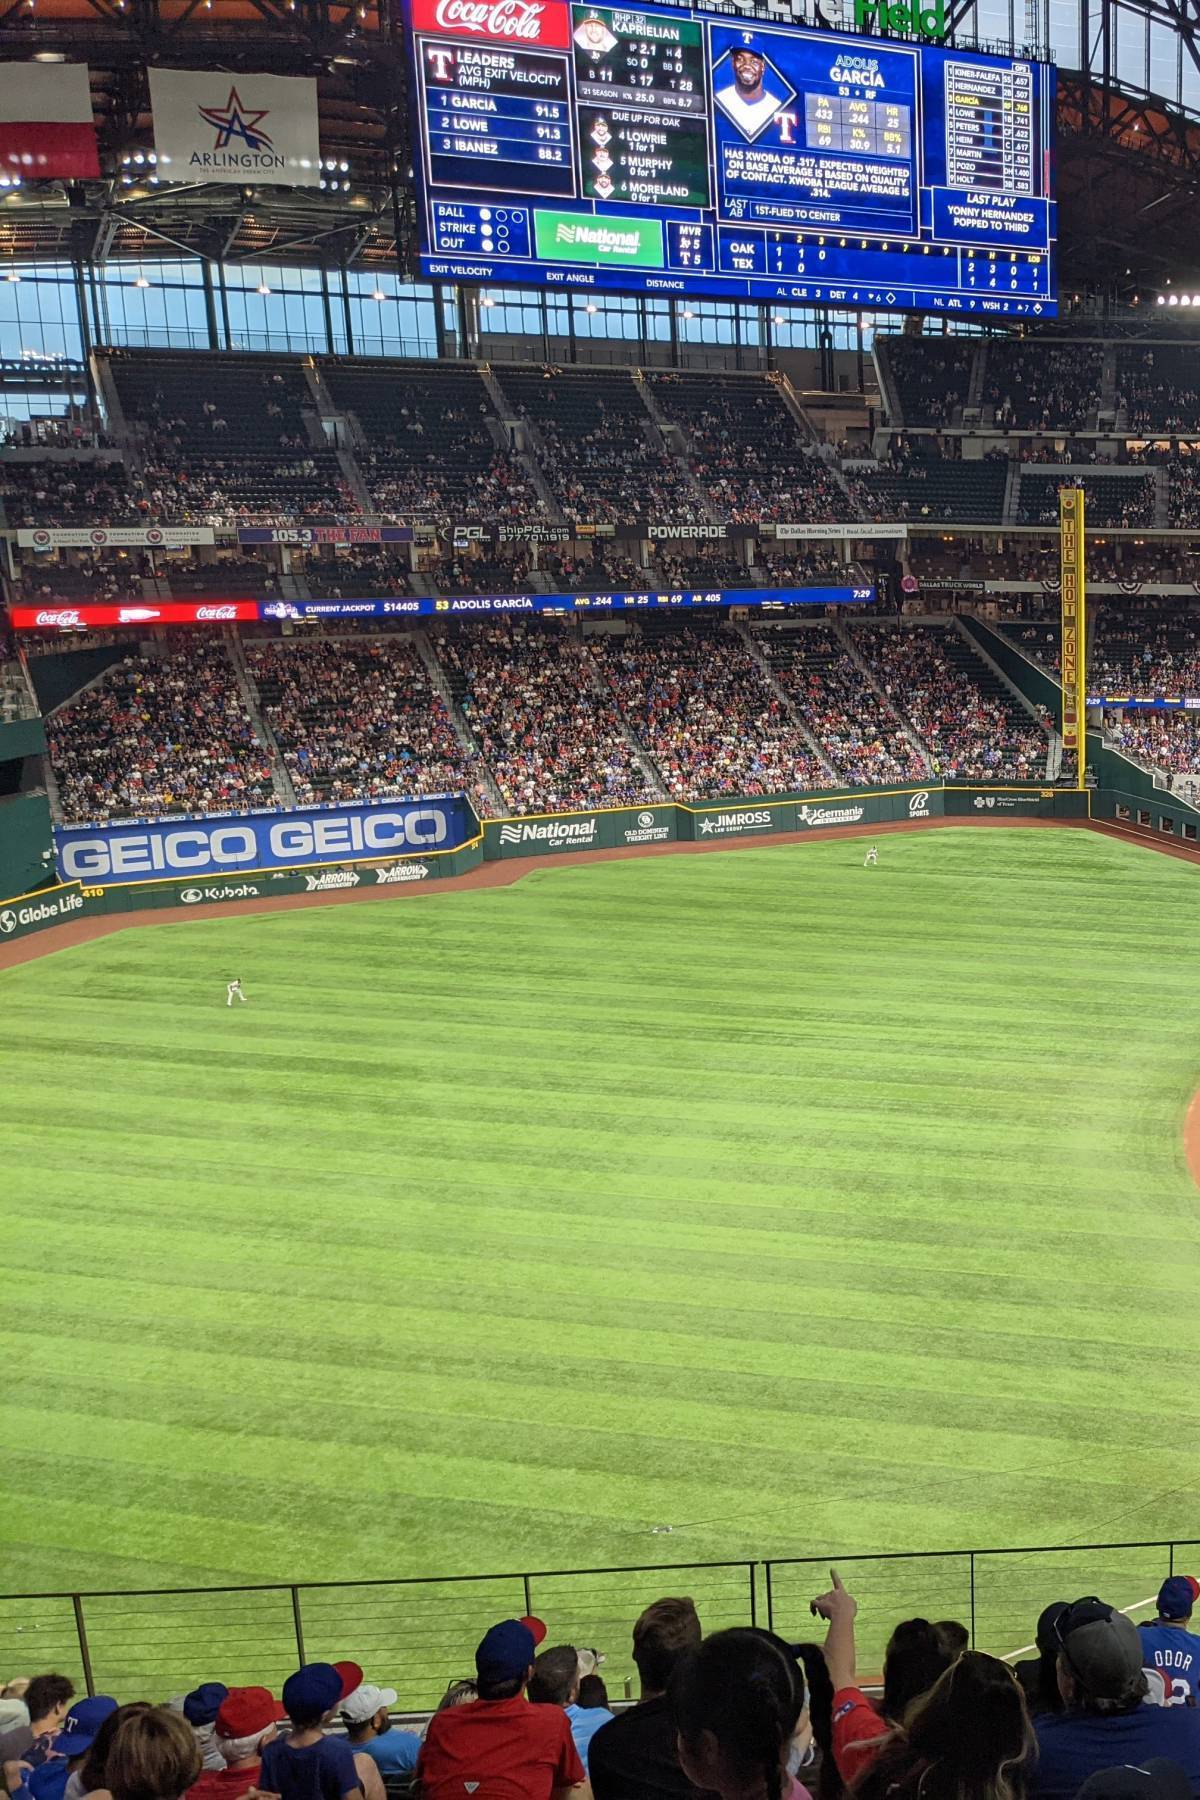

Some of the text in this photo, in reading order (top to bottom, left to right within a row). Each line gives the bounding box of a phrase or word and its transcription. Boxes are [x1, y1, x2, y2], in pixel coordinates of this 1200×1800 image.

[436, 0, 546, 39] Coca-Cola
[854, 0, 945, 37] Field
[612, 22, 680, 40] KAPRIELIAN
[457, 50, 515, 69] LEADERS
[836, 55, 879, 71] ADOLIS
[458, 65, 562, 86] AVG EXIT VELOCITY
[459, 75, 491, 89] (MPH)
[829, 67, 886, 88] GARCÍA
[452, 97, 560, 119] GARCIA 91.5
[612, 112, 680, 127] DUE UP FOR OAK
[454, 118, 561, 140] LOWE 91.3
[627, 131, 667, 145] LOWRIE
[455, 140, 562, 161] IBANEZ 88.2
[189, 152, 285, 168] ARLINGTON
[628, 157, 673, 170] MURPHY
[724, 149, 744, 160] HAS
[745, 151, 780, 164] XWOBA
[782, 155, 795, 165] OF
[819, 160, 864, 173] EXPECTED
[865, 164, 910, 178] WEIGHTED
[728, 159, 907, 187] ON BASE AVERAGE IS BASED ON QUALITY
[629, 182, 689, 197] MORELAND
[726, 169, 910, 197] OF CONTACT. XWOBA LEAGUE AVERAGE IS
[724, 198, 749, 209] LAST
[966, 193, 1016, 208] LAST PLAY
[438, 206, 465, 218] BALL
[729, 209, 743, 218] AB
[755, 205, 841, 222] 1ST-FLIED TO CENTER
[947, 205, 1034, 223] YONNY HERNANDEZ
[440, 222, 476, 234] STRIKE
[953, 217, 1030, 233] POPPED TO THIRD
[441, 237, 465, 249] OUT
[575, 226, 640, 247] National
[730, 243, 755, 254] OAK
[429, 264, 493, 277] EXIT VELOCITY
[732, 258, 754, 270] TEX
[546, 271, 595, 284] EXIT ANGLE
[646, 279, 685, 289] DISTANCE
[271, 528, 381, 542] 105.3 THE FAN
[453, 526, 491, 540] PGL
[498, 525, 570, 535] ShipPGL.com
[648, 526, 728, 538] POWERADE
[791, 527, 806, 535] Dallas
[807, 527, 828, 537] Morning
[1063, 517, 1077, 563] THE
[853, 590, 870, 598] 7:29
[1063, 573, 1077, 617] HOT
[305, 604, 340, 613] CURRENT
[341, 604, 376, 613] JACKPOT
[383, 601, 420, 612] $14405
[435, 594, 721, 610] 53 ADOLIS GARCÍA .244 25 69 405
[36, 610, 81, 625] Coca-Cola
[196, 604, 238, 620] Coca-Cola
[1063, 626, 1077, 684] ZONE
[715, 811, 771, 827] JIMROSS
[816, 806, 863, 819] Germania
[909, 809, 930, 818] SPORTS
[522, 819, 597, 841] National
[624, 827, 669, 837] OLD DOMINION
[626, 832, 668, 843] FREIGHT LINE
[62, 810, 447, 878] GEICO GEICO
[549, 835, 594, 846] Car Rental
[318, 871, 353, 884] ARROW
[389, 864, 421, 877] ARROW
[82, 889, 104, 897] 410
[205, 884, 260, 899] Kubota
[19, 894, 84, 926] Globe Life
[1154, 1649, 1193, 1671] ODOR
